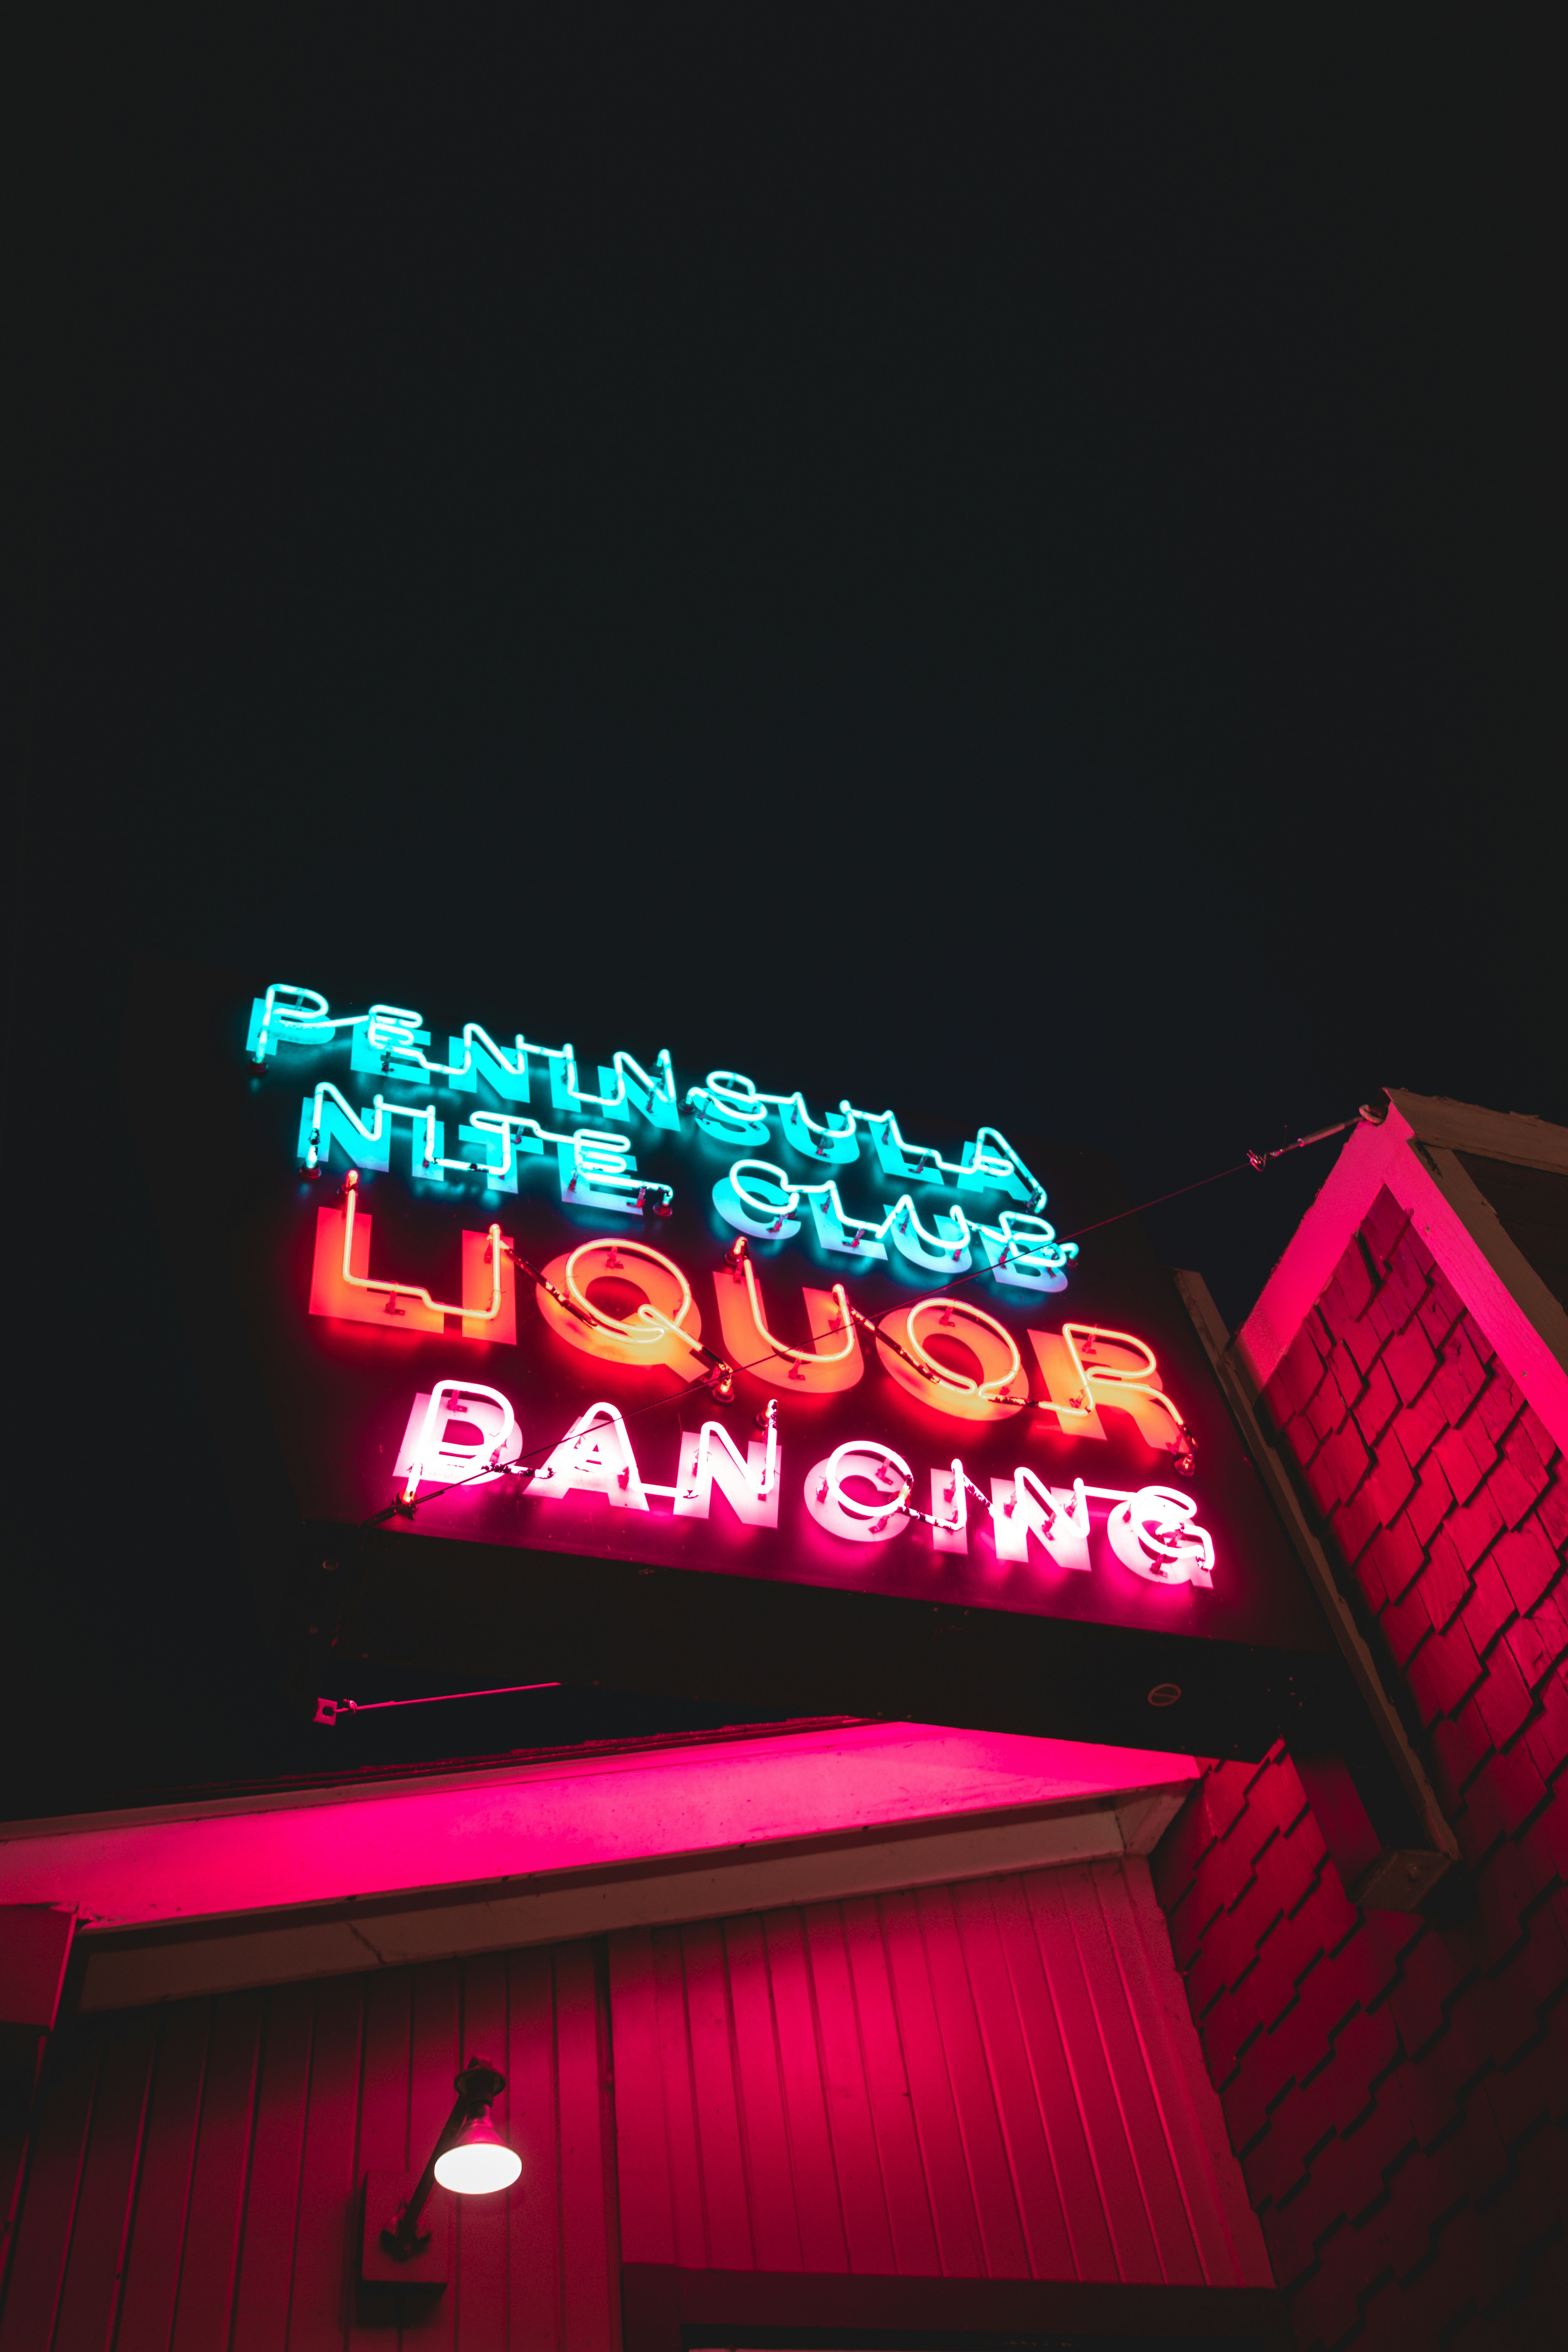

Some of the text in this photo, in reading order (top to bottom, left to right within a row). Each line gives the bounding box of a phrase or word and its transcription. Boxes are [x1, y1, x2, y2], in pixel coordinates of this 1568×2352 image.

[247, 983, 1047, 1212] PENINSULA
[297, 1082, 1078, 1293] NITE CLUB
[309, 1171, 1195, 1456] LIQUOR
[392, 1380, 1215, 1589] DANCING
